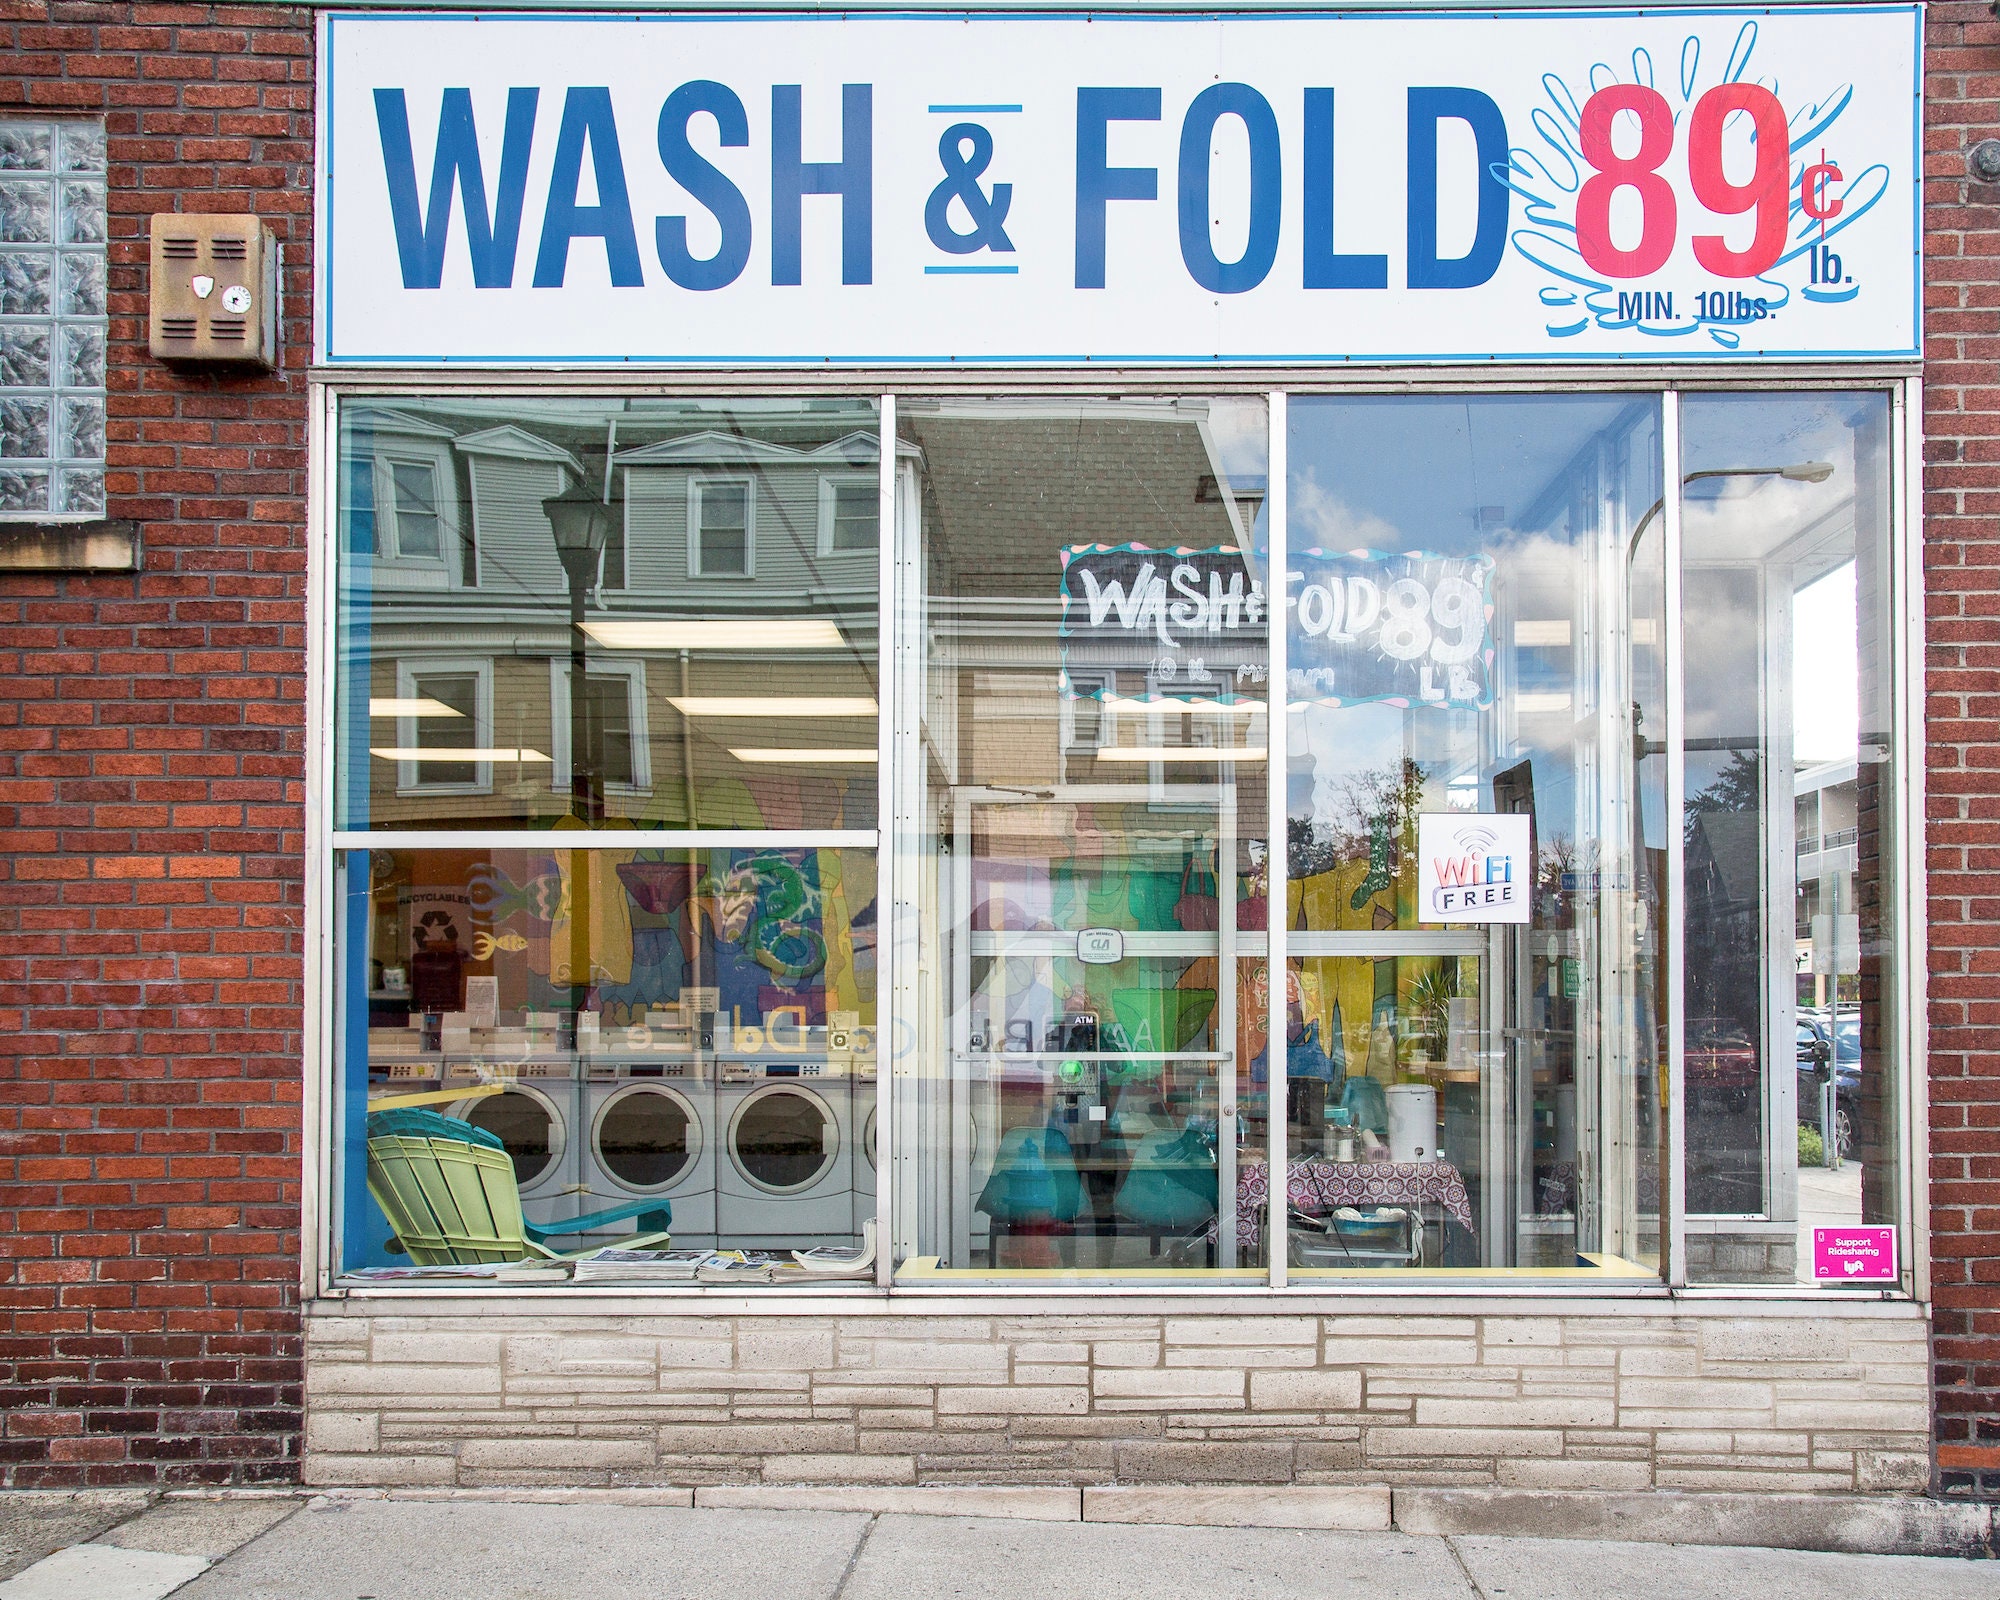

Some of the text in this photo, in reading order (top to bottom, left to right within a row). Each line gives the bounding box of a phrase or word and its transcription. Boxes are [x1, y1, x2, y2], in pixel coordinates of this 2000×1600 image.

[373, 79, 872, 291] WASH
[925, 123, 1016, 254] &
[1074, 82, 1511, 295] FOLD
[1810, 245, 1853, 284] lb.
[1617, 291, 1777, 320] MIN. 10lbs.
[1078, 562, 1245, 648] WASH
[1419, 665, 1482, 700] LB
[1433, 851, 1512, 889] WiFi
[398, 893, 471, 906] RECYCLABLES
[1443, 887, 1512, 909] FREE
[1090, 938, 1111, 951] CLA
[1074, 1016, 1094, 1025] ATM
[1827, 1247, 1880, 1257] Ridesharing
[1835, 1238, 1872, 1248] Support
